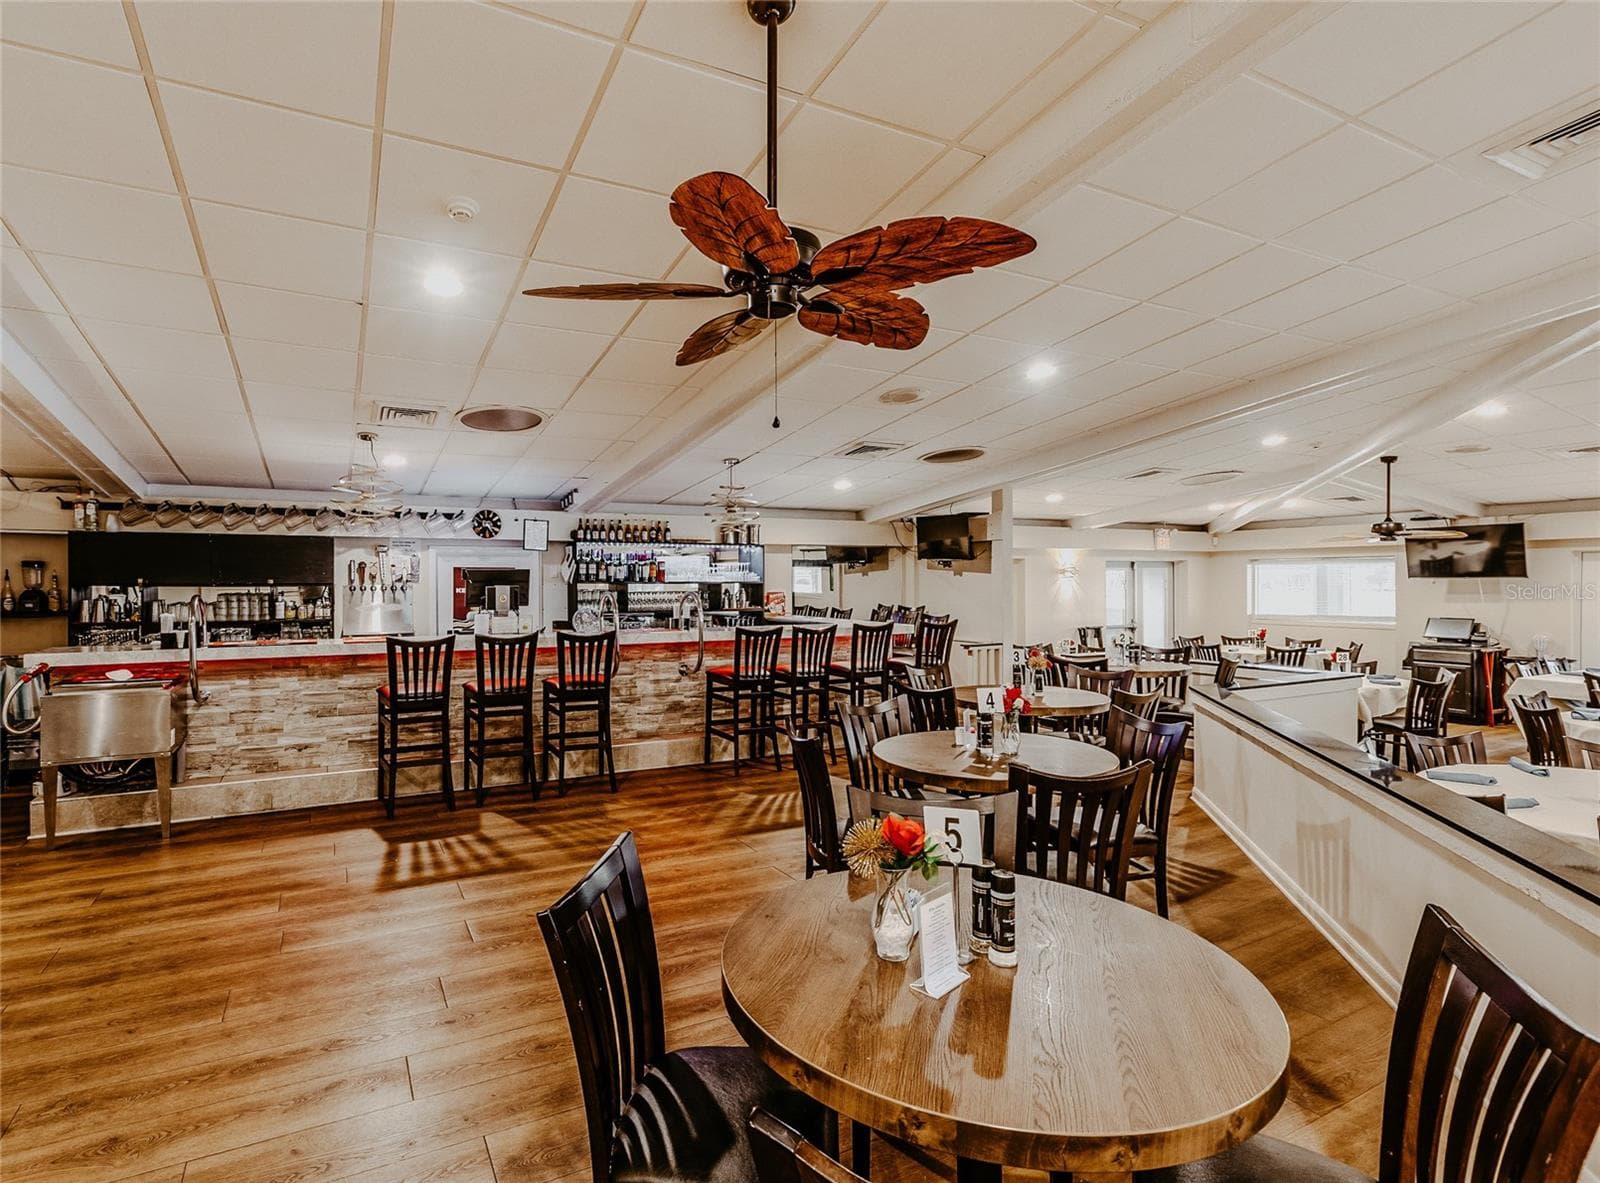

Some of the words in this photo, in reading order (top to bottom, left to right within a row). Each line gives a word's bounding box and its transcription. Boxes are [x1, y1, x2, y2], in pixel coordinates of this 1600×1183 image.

[1120, 633, 1125, 642] 2
[1013, 651, 1020, 662] 3
[986, 692, 995, 708] 4
[944, 817, 962, 852] 5
